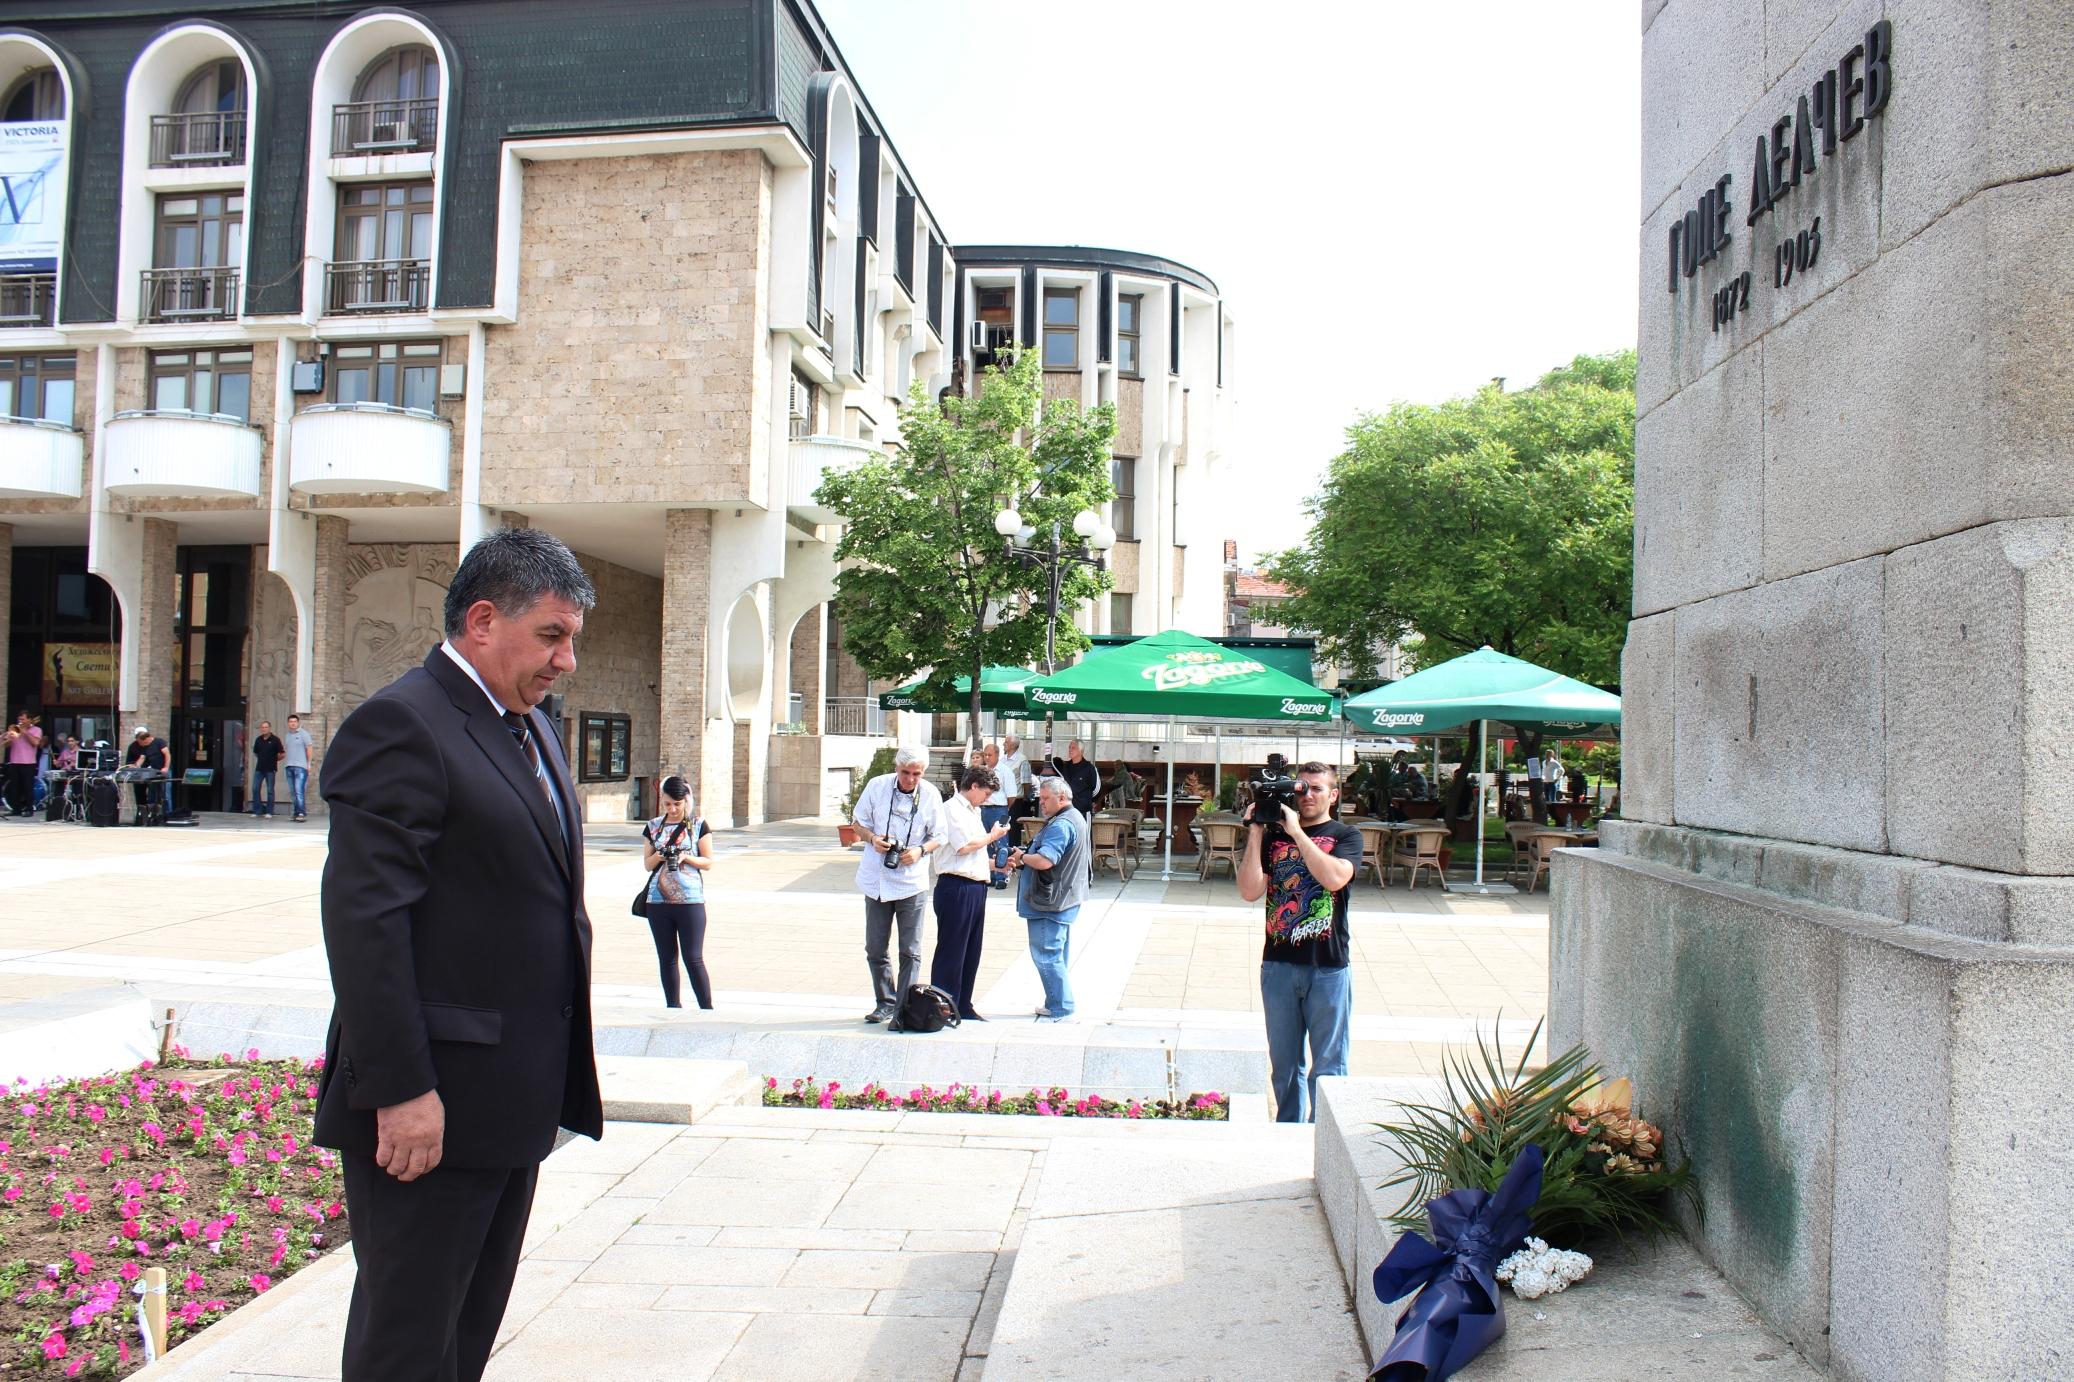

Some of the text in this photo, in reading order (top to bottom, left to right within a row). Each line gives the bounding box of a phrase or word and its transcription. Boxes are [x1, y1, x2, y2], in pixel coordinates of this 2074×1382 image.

[3, 126, 58, 137] VICTORIA
[1668, 19, 1892, 293] ГОЦЕ ДЕЛЧЕВ
[1711, 270, 1750, 332] 1872
[1140, 661, 1267, 692] Zagorka
[1031, 687, 1077, 705] Zagorka
[1280, 697, 1326, 716] Zagorka
[1371, 708, 1425, 728] Zagorka
